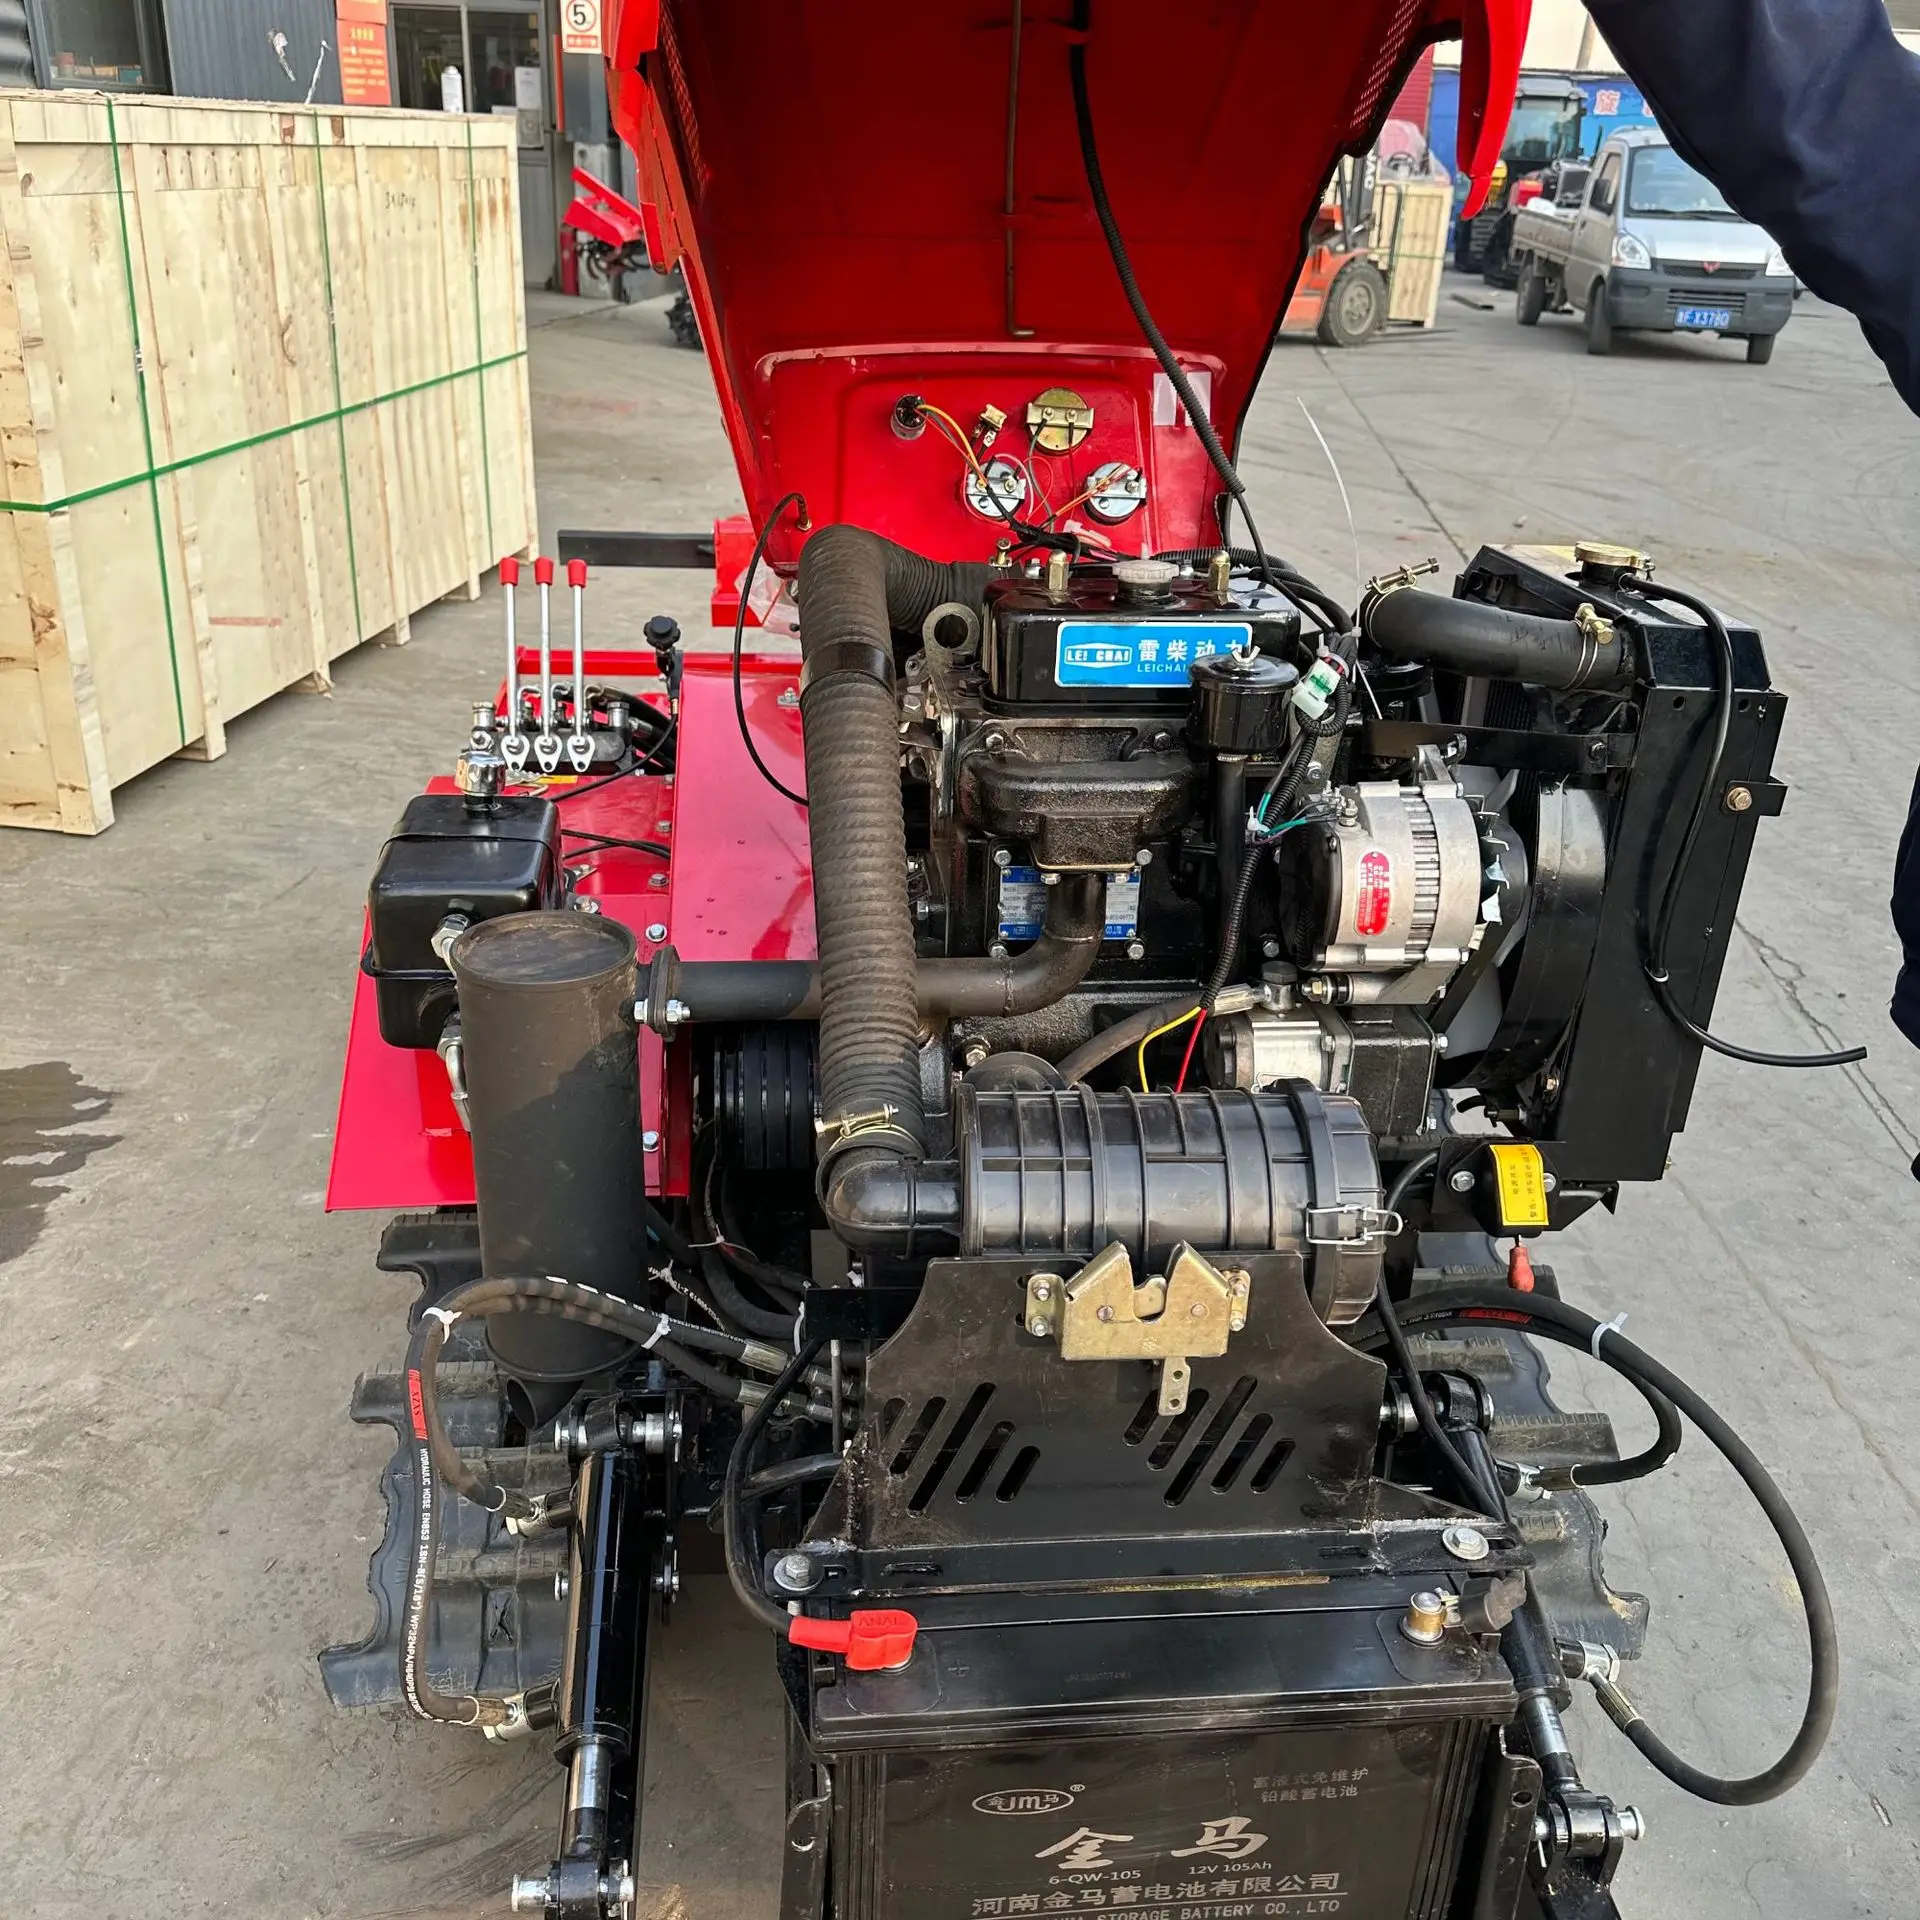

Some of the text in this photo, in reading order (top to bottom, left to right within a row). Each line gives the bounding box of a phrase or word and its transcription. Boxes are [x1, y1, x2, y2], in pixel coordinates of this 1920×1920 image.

[573, 4, 586, 26] 5
[1066, 649, 1130, 663] LEI CHAI
[1136, 663, 1187, 673] LEICHAI
[419, 1448, 431, 1486] HYDRAULIC
[422, 1488, 432, 1510] HOSE
[421, 1512, 432, 1541] EN853
[1261, 1784, 1359, 1803] 铅酸蓄电池
[1049, 1869, 1142, 1885] 6-QW-105
[1188, 1861, 1272, 1875] 12V 105Ah
[972, 1872, 1340, 1916] 河南金马蓄电池有限公司
[1180, 1903, 1255, 1920] BATTERY
